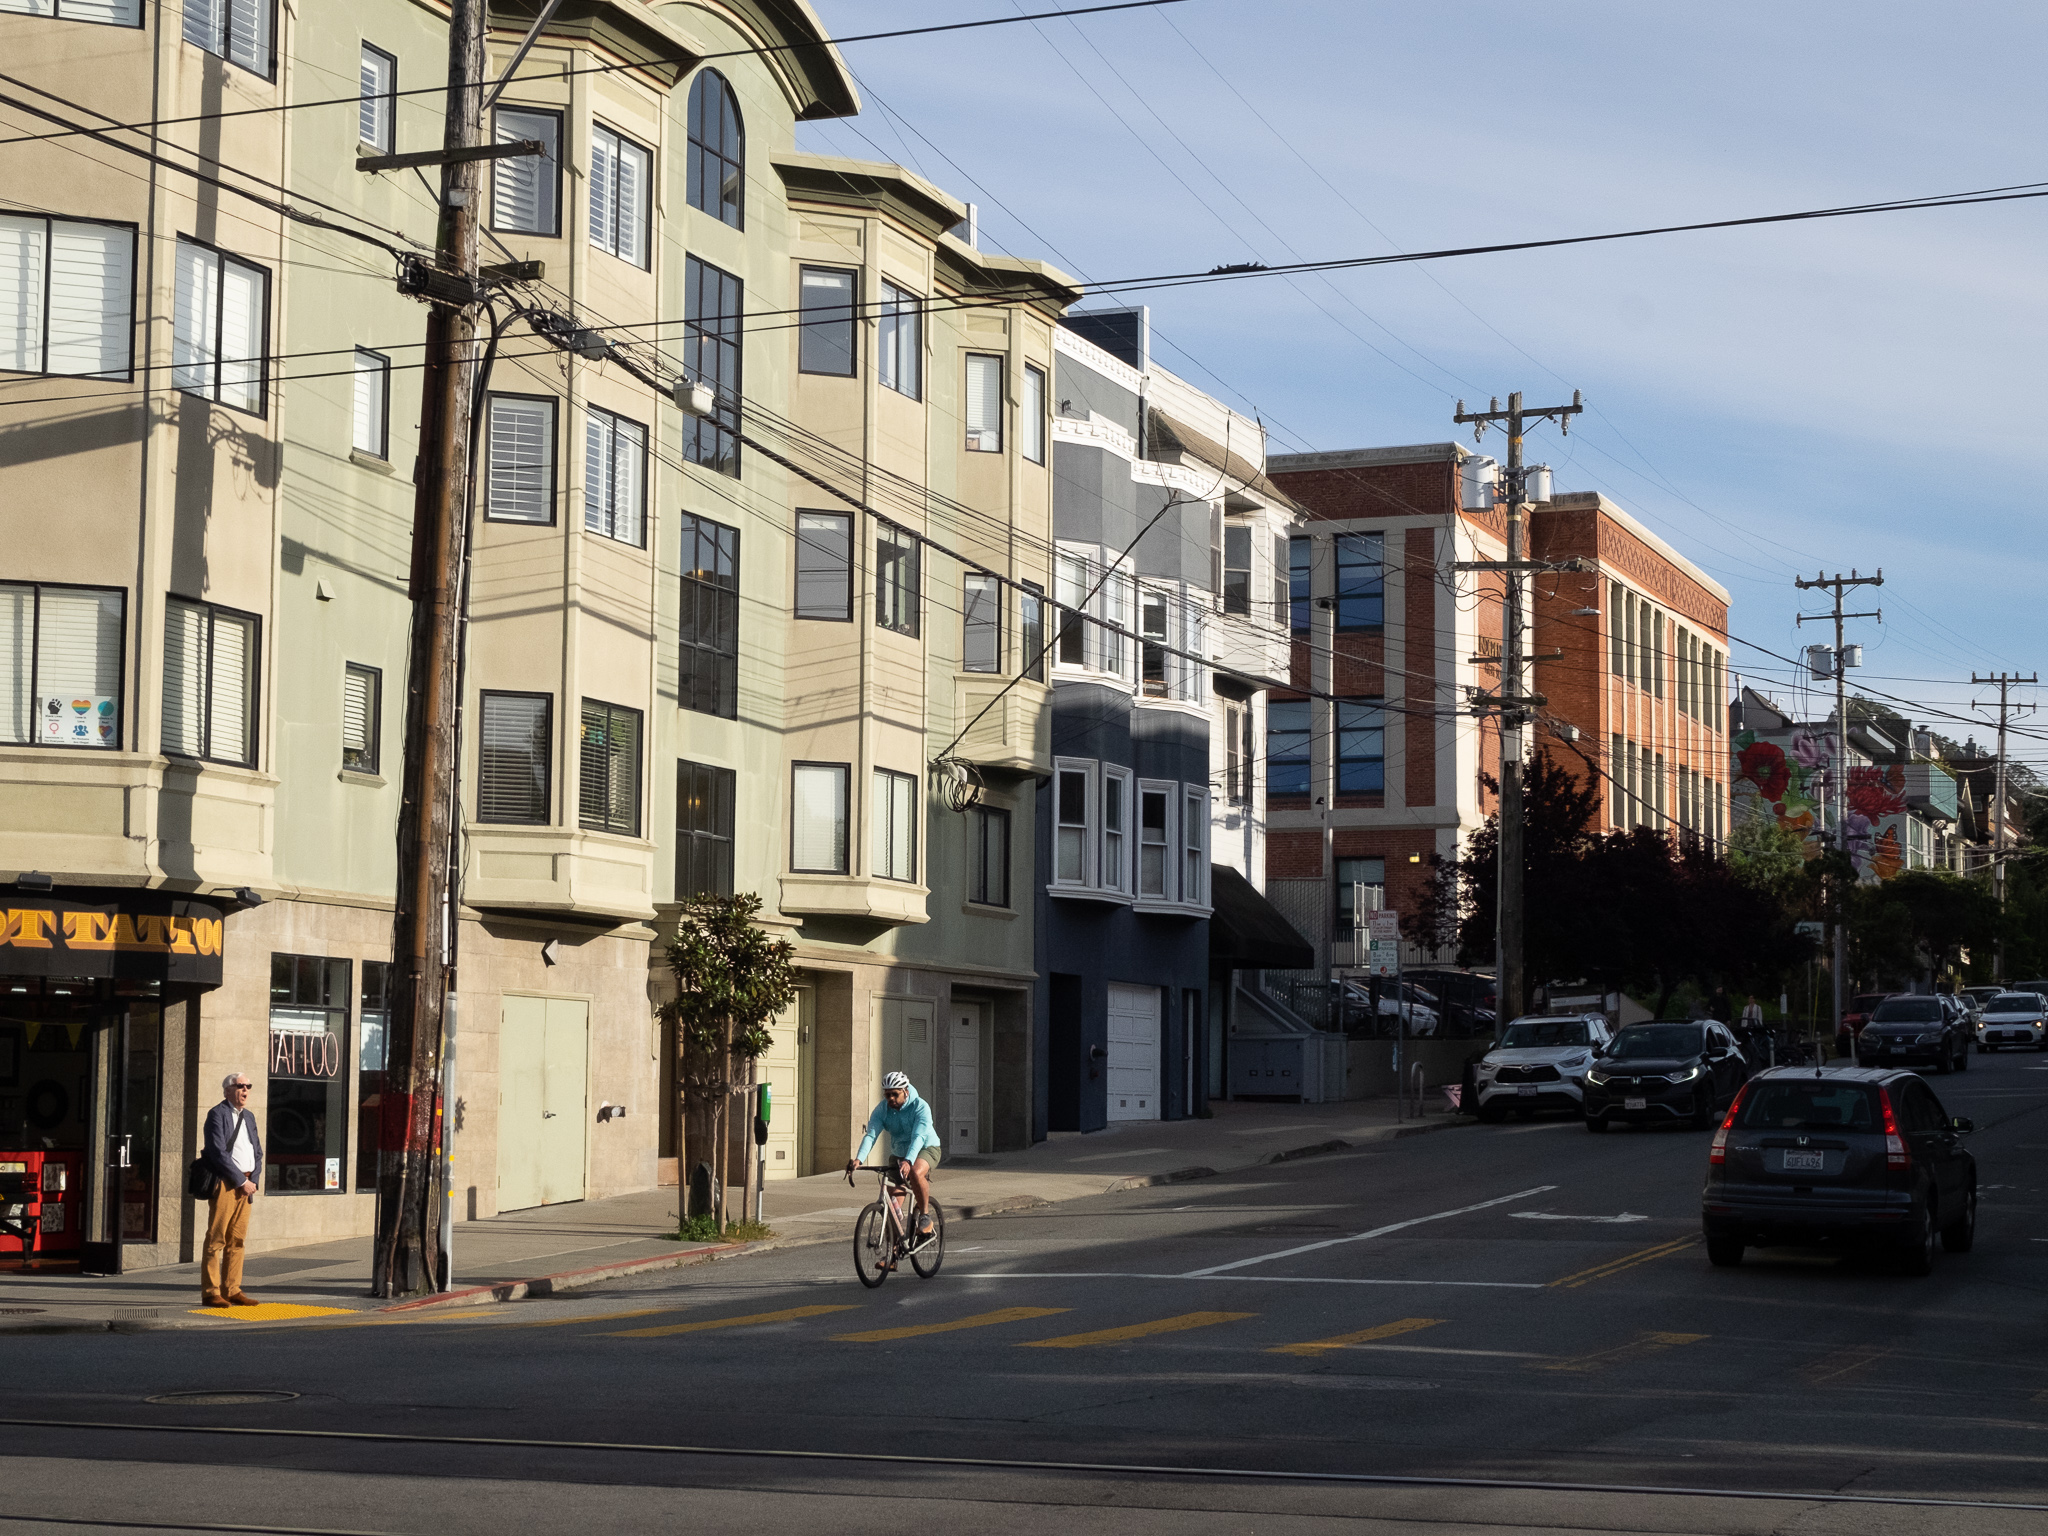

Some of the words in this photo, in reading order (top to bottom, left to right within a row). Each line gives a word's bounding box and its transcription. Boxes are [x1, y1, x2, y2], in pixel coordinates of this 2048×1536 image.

[62, 911, 223, 957] TATTOO
[1371, 941, 1377, 950] 2
[269, 1030, 339, 1077] TATTOO
